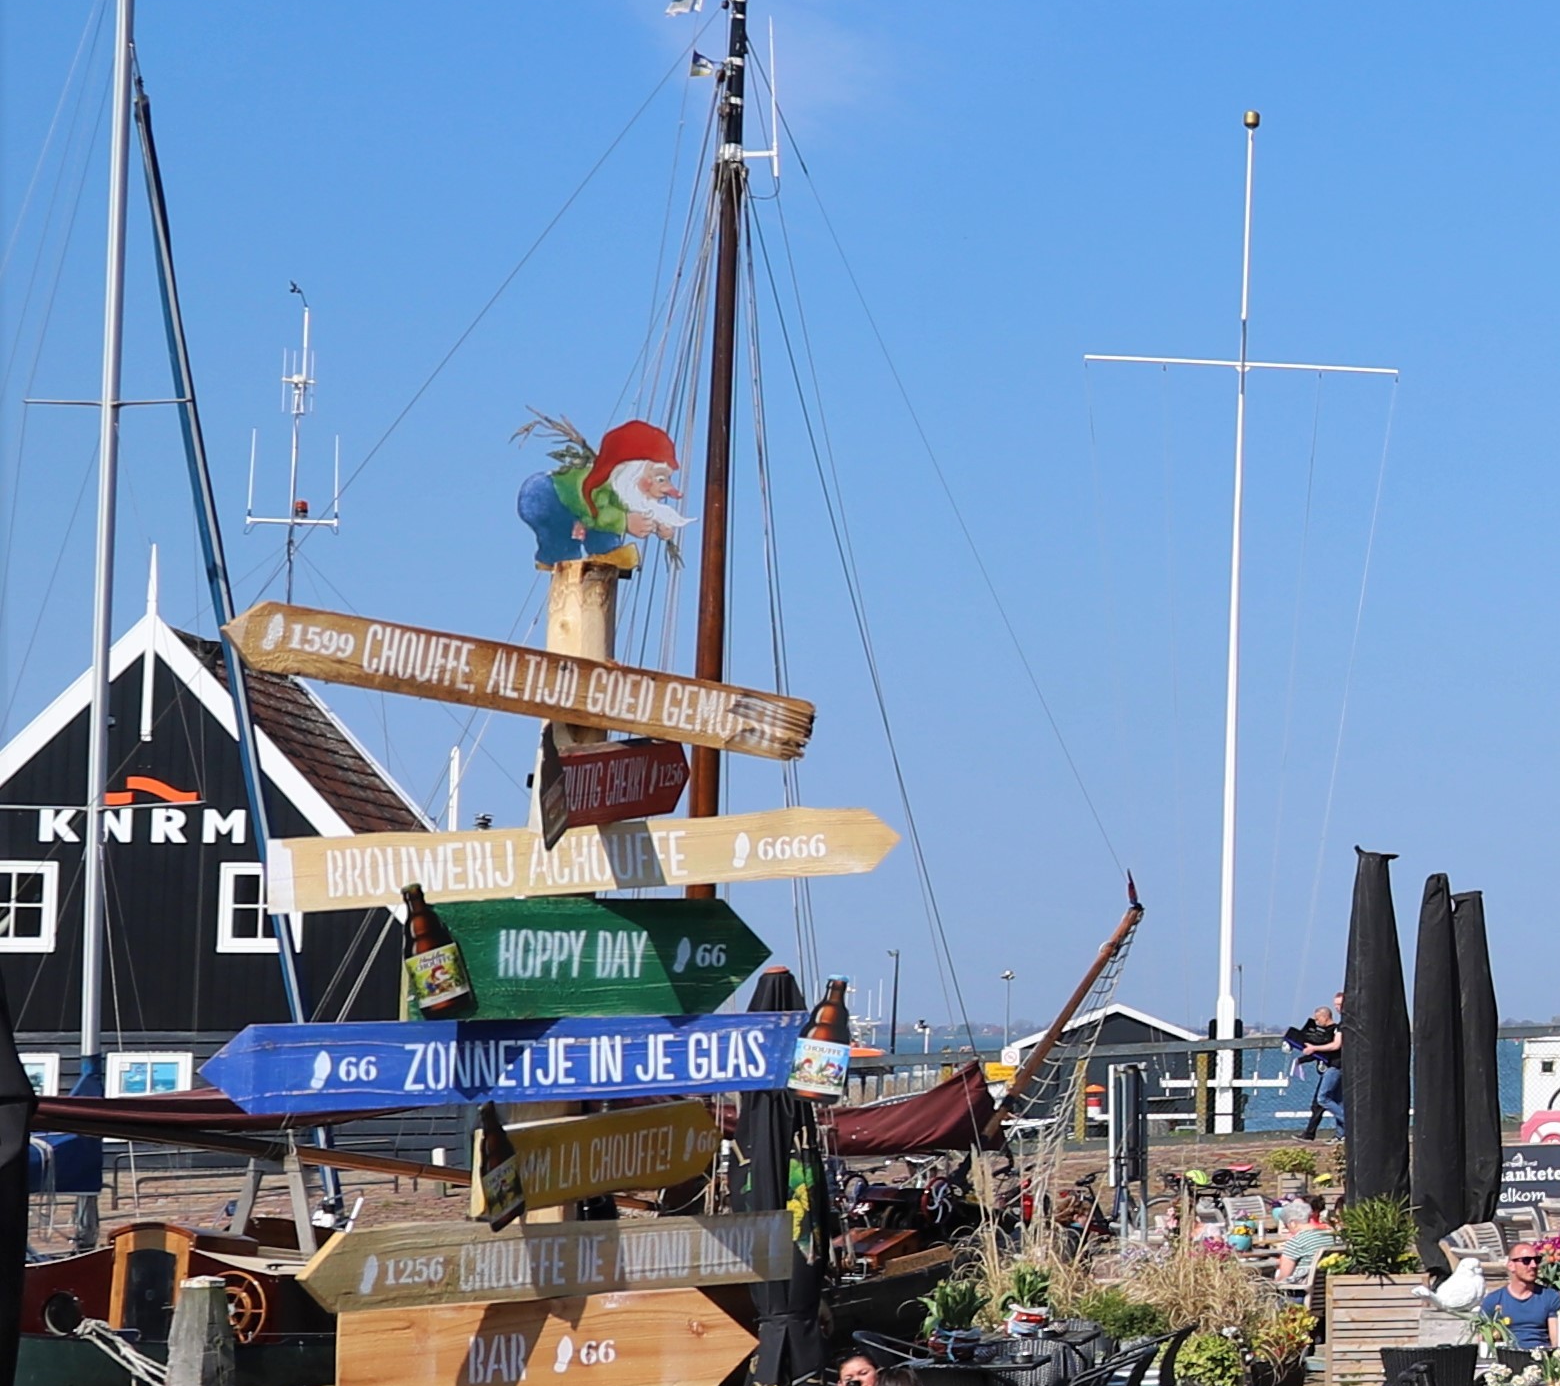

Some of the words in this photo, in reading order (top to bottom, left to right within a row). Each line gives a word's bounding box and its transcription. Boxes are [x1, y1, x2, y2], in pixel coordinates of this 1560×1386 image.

[288, 623, 355, 659] 1599
[362, 623, 476, 694] CHOUFFE,
[485, 647, 579, 709] ALTIJD
[586, 667, 655, 724] GOED
[563, 760, 604, 812] RUITIG
[38, 808, 246, 845] KNRM
[326, 839, 515, 898] BROUWERIJ
[529, 830, 689, 888] ACHOUFFE
[757, 833, 827, 861] 6666
[498, 929, 587, 980] HOPPY
[595, 930, 648, 979] DAY
[695, 943, 727, 967] 66
[338, 1056, 378, 1082] 66
[403, 1037, 577, 1091] ZONNETJE
[589, 1035, 622, 1084] IN
[635, 1033, 675, 1082] JE
[687, 1029, 766, 1081] GLAS
[802, 1043, 843, 1057] CHOUFFE
[559, 1140, 581, 1189] LA
[589, 1125, 674, 1184] CHOUFFE!
[1500, 1187, 1546, 1203] elkom
[385, 1256, 445, 1286] 1256
[459, 1236, 567, 1293] CHOUFFE
[577, 1235, 606, 1284] DE
[615, 1229, 691, 1282] AVOND
[468, 1333, 527, 1385] BAR
[579, 1339, 616, 1366] 66
